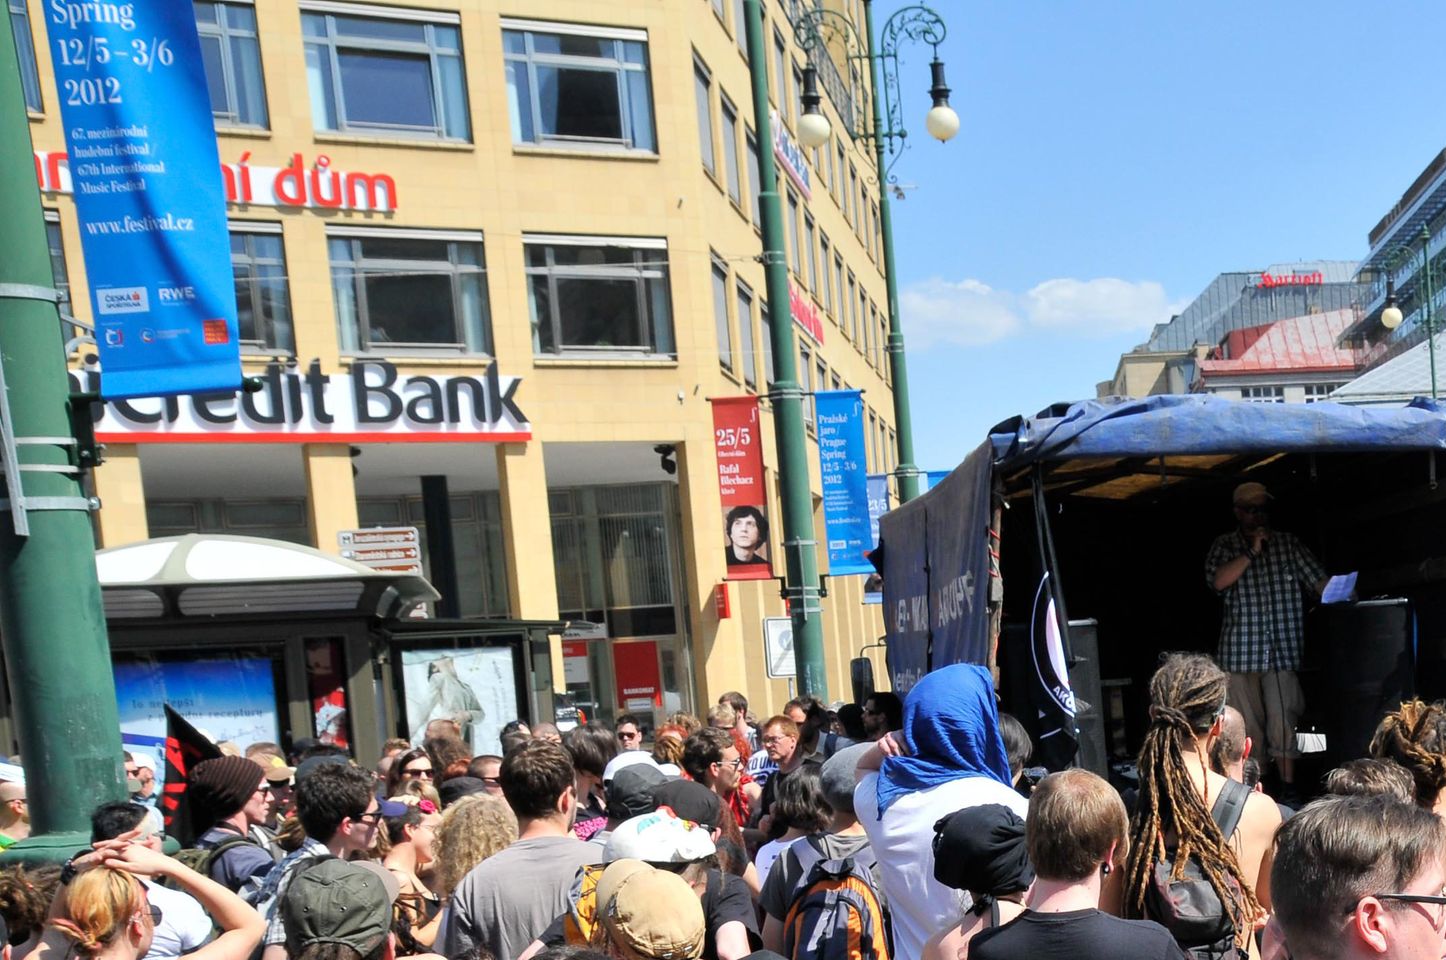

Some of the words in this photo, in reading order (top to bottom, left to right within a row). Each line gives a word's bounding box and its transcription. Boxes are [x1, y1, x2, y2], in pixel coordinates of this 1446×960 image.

[52, 0, 136, 31] Spring
[64, 77, 122, 106] 2012
[101, 160, 165, 175] International
[80, 182, 110, 195] Music
[111, 178, 146, 193] Festival
[274, 152, 398, 210] dům
[86, 212, 194, 235] www.festival.cz
[158, 286, 196, 300] RWE
[352, 358, 529, 425] Bank
[716, 427, 751, 449] 25/5
